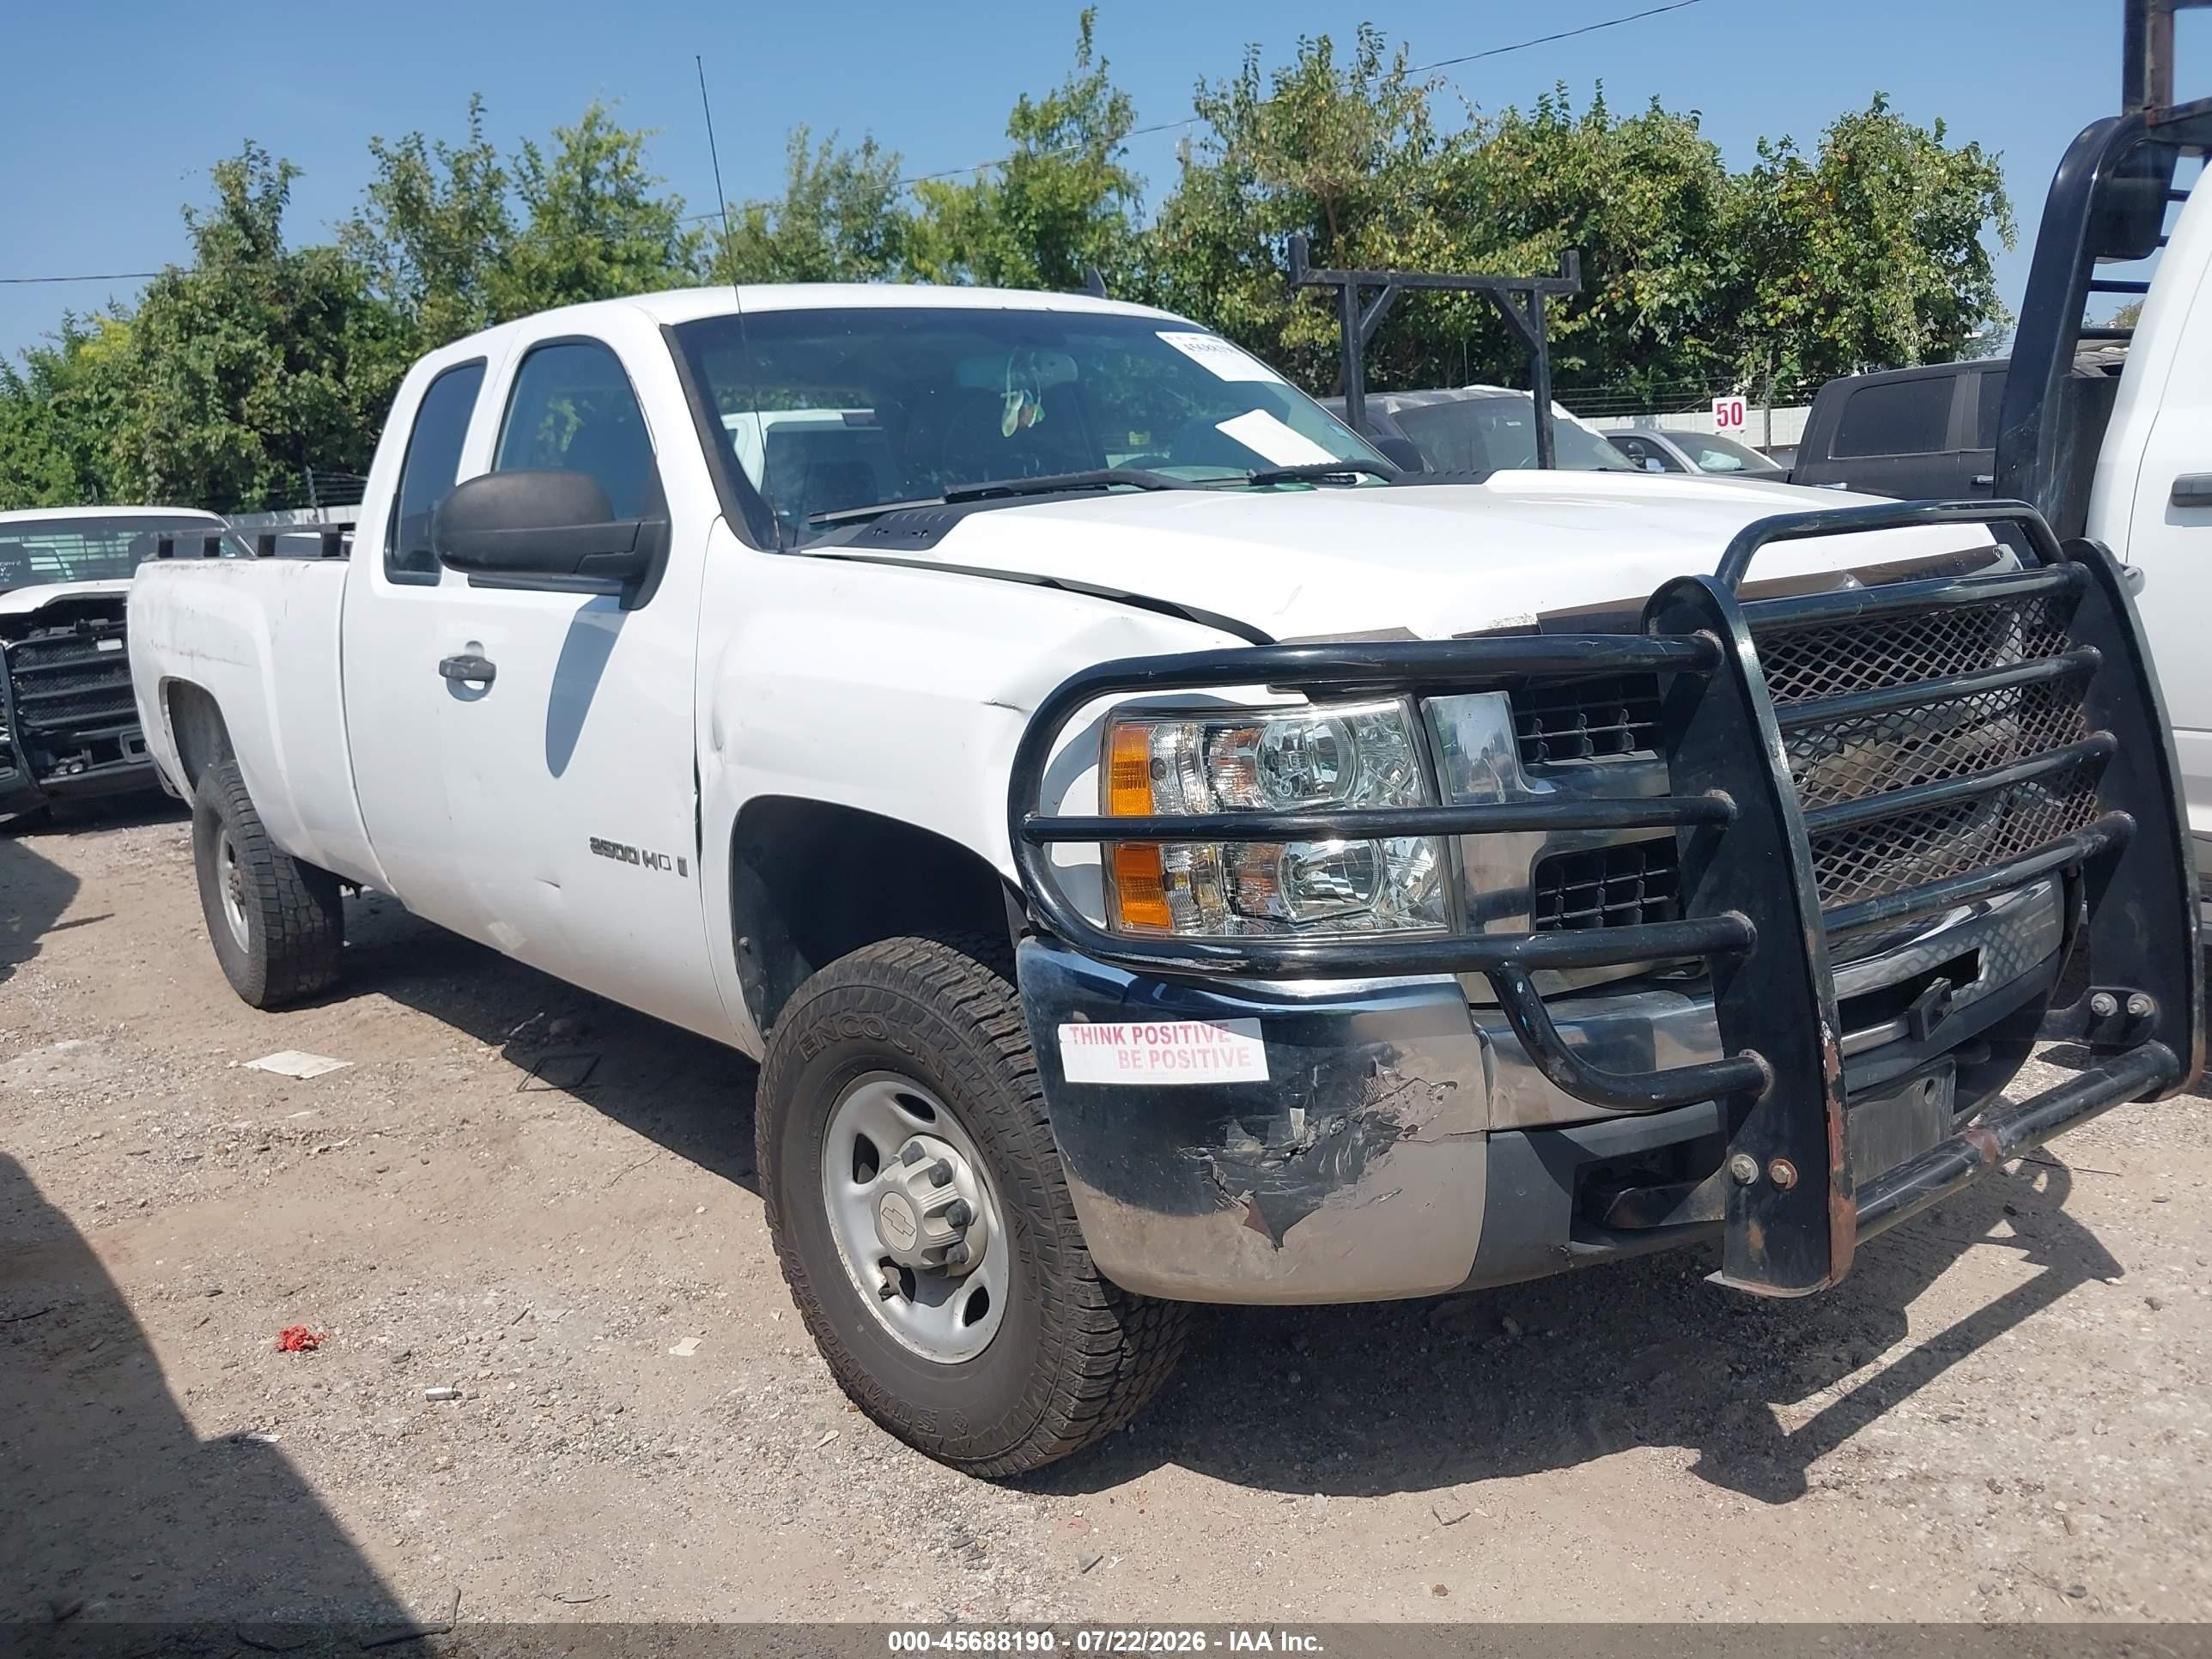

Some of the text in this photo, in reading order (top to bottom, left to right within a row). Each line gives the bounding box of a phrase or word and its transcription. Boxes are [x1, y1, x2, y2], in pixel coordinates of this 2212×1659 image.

[1716, 402, 1743, 428] 50
[589, 836, 672, 871] 2500 HD
[1069, 1022, 1232, 1046] THINK POSITIVE
[1117, 1047, 1252, 1071] BE POSITIVE
